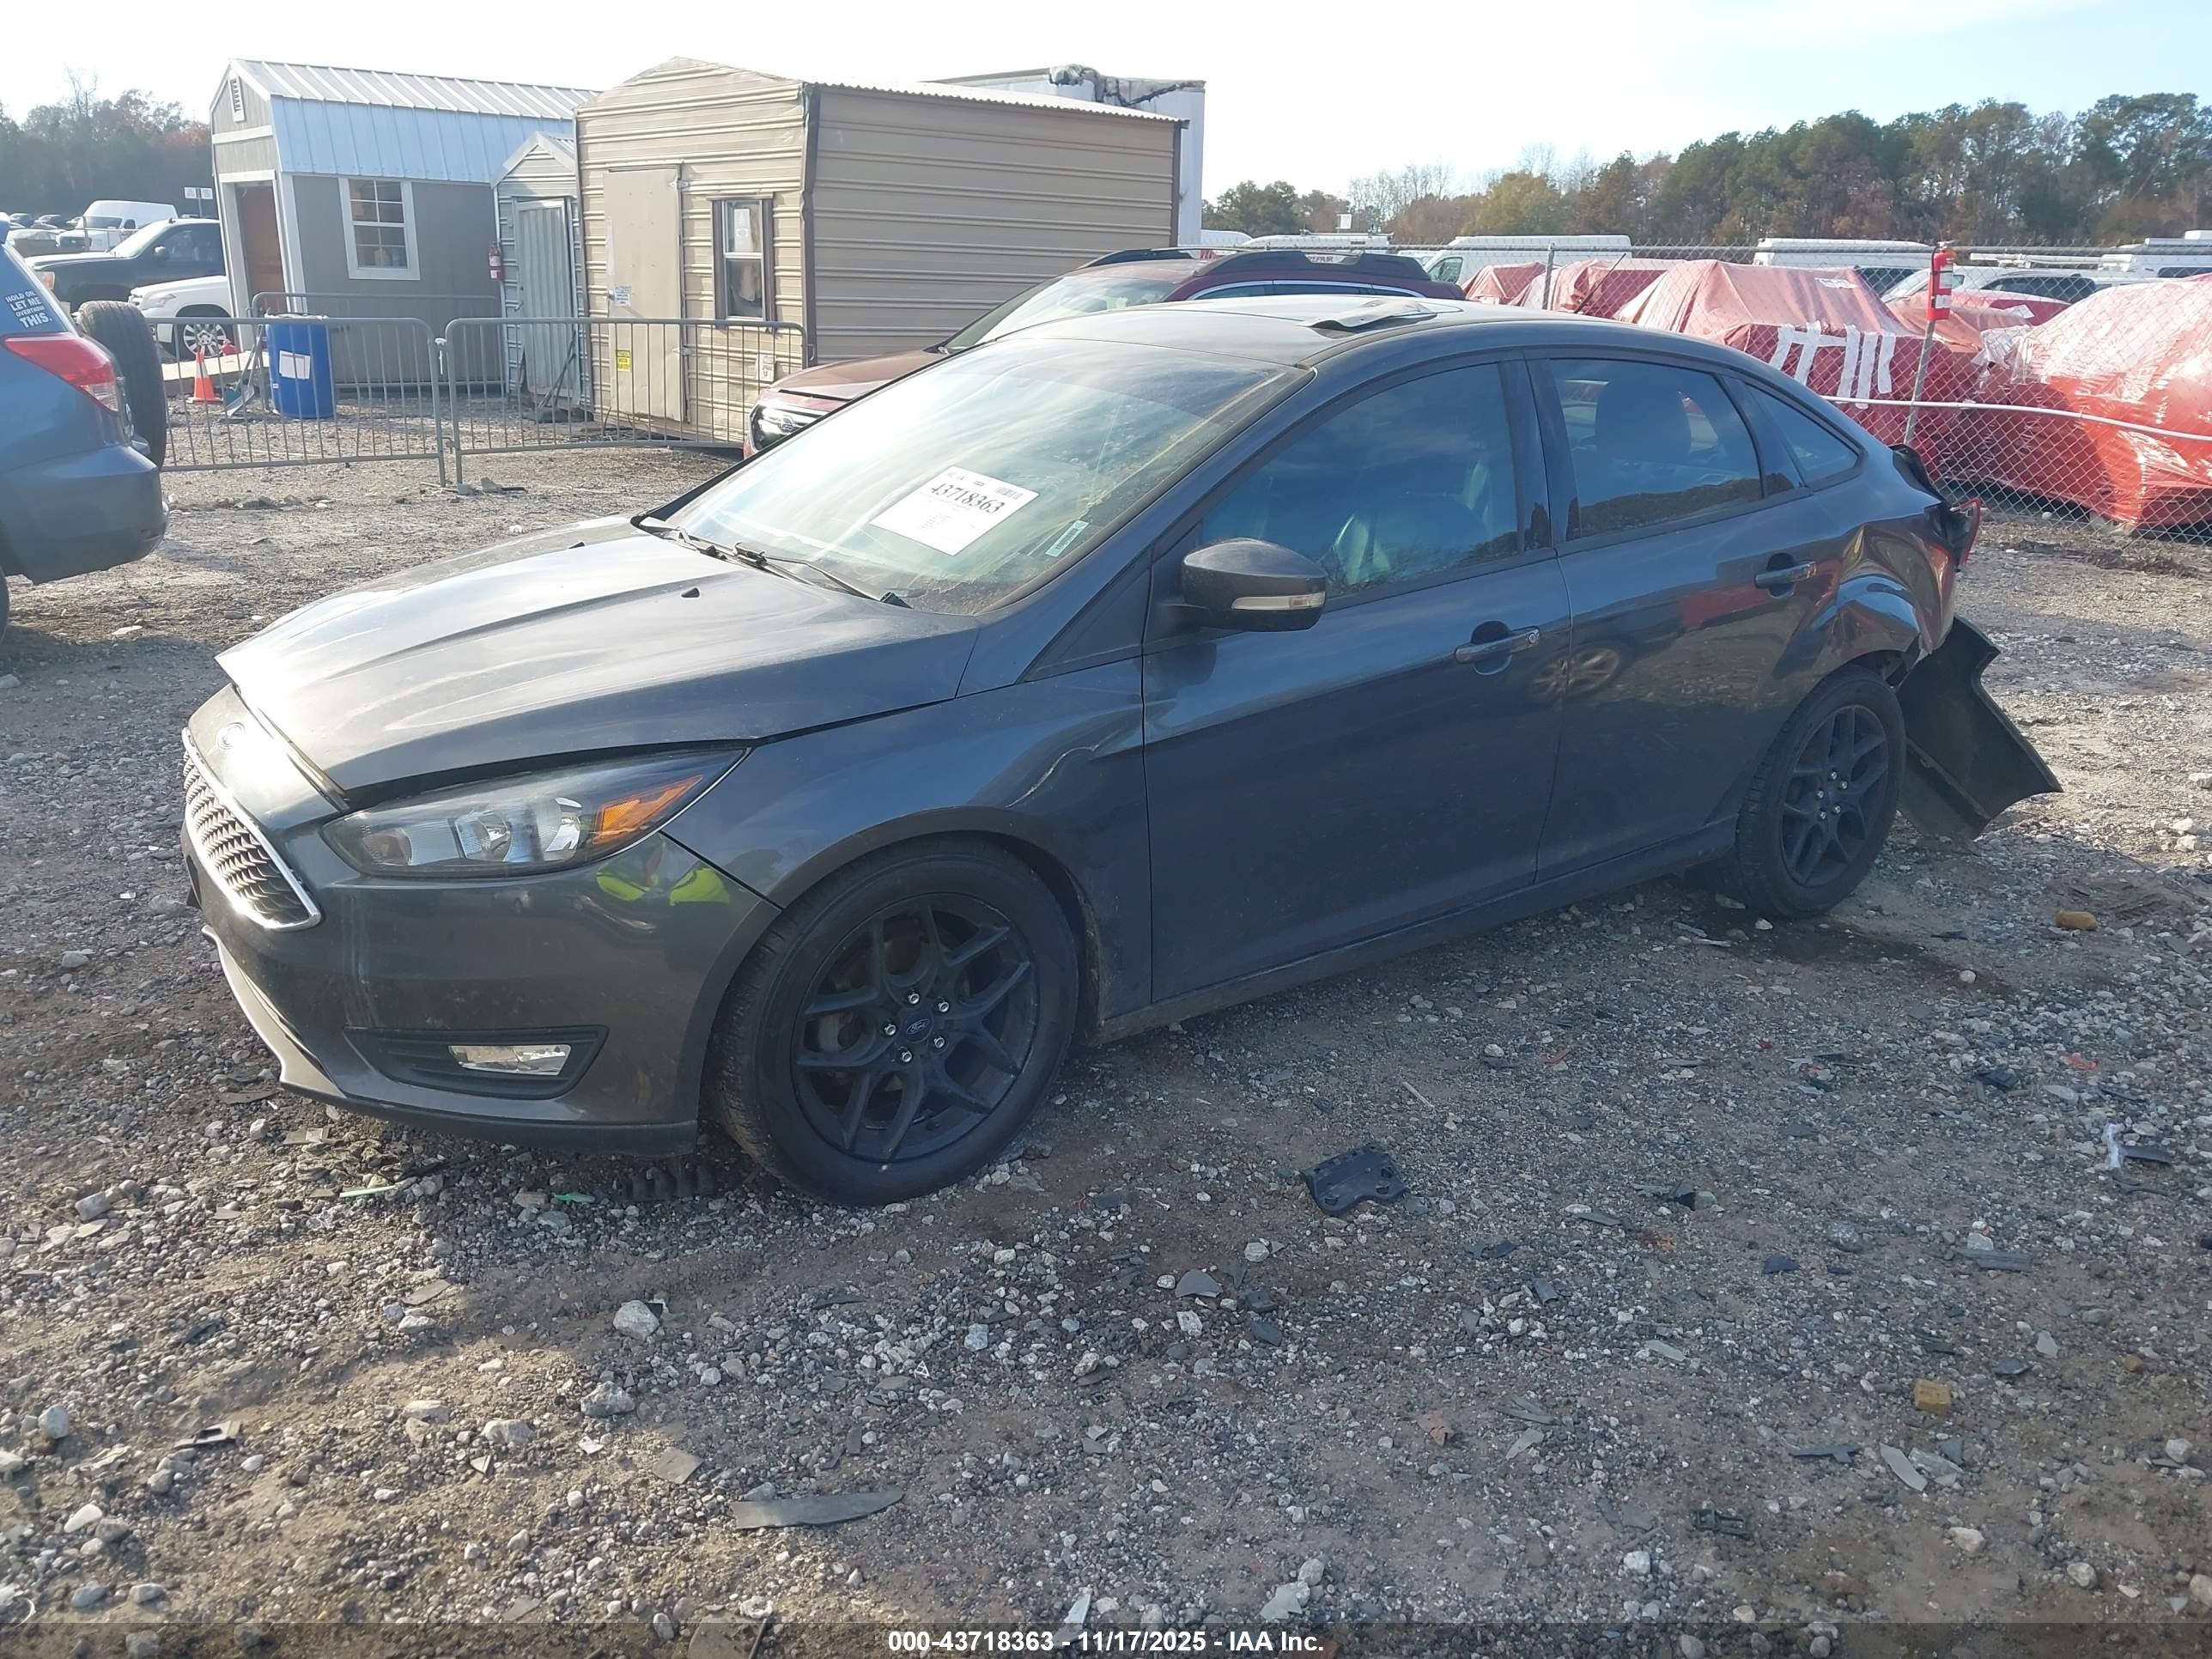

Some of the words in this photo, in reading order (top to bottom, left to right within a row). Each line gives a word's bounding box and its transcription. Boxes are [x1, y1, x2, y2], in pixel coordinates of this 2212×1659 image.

[5, 293, 25, 302] HOLD
[10, 301, 27, 311] LET
[27, 297, 41, 307] ME
[19, 313, 52, 328] THIS.
[930, 483, 1006, 514] 43718363
